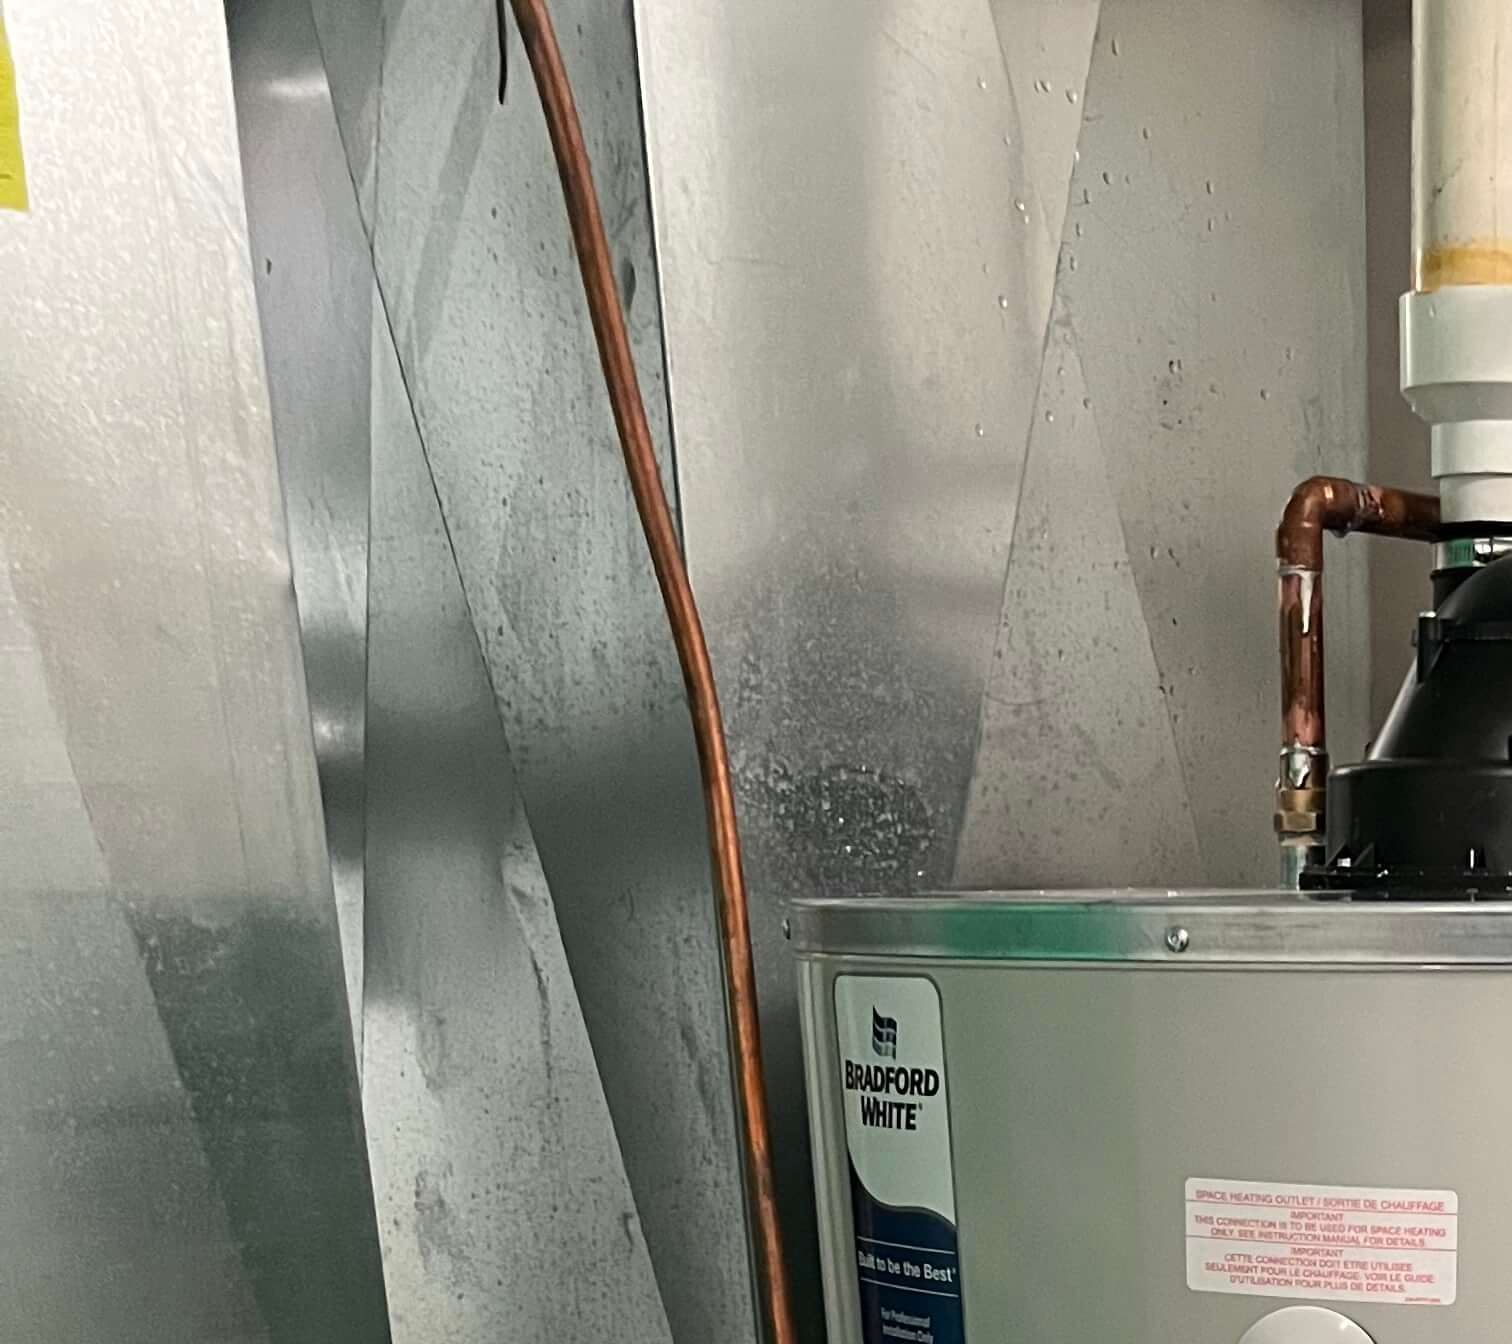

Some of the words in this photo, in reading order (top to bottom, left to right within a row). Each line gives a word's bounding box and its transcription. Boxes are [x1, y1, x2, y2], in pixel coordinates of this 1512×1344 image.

[845, 1059, 940, 1096] BRADFORD
[861, 1095, 917, 1131] WHITE
[1195, 1191, 1226, 1200] SPACE
[1230, 1193, 1272, 1203] HEATING
[1275, 1195, 1314, 1206] OUTLET
[1323, 1199, 1360, 1208] SORTIE
[1363, 1200, 1377, 1208] DE
[1381, 1201, 1444, 1210] CHAUFFAGE
[1194, 1215, 1213, 1224] THIS
[1216, 1216, 1276, 1228] CONNECTION
[1279, 1221, 1287, 1229] IS
[1291, 1222, 1302, 1230] TO
[1305, 1222, 1316, 1231] BE
[1320, 1223, 1344, 1233] USED
[1348, 1225, 1367, 1233] FOR
[1371, 1226, 1400, 1234] SPACE
[1404, 1227, 1446, 1236] HEATING
[1290, 1212, 1344, 1221] IMPORTANT
[1290, 1248, 1344, 1257] IMPORTANT
[876, 1257, 887, 1271] to
[888, 1257, 901, 1274] be
[902, 1260, 921, 1278] the
